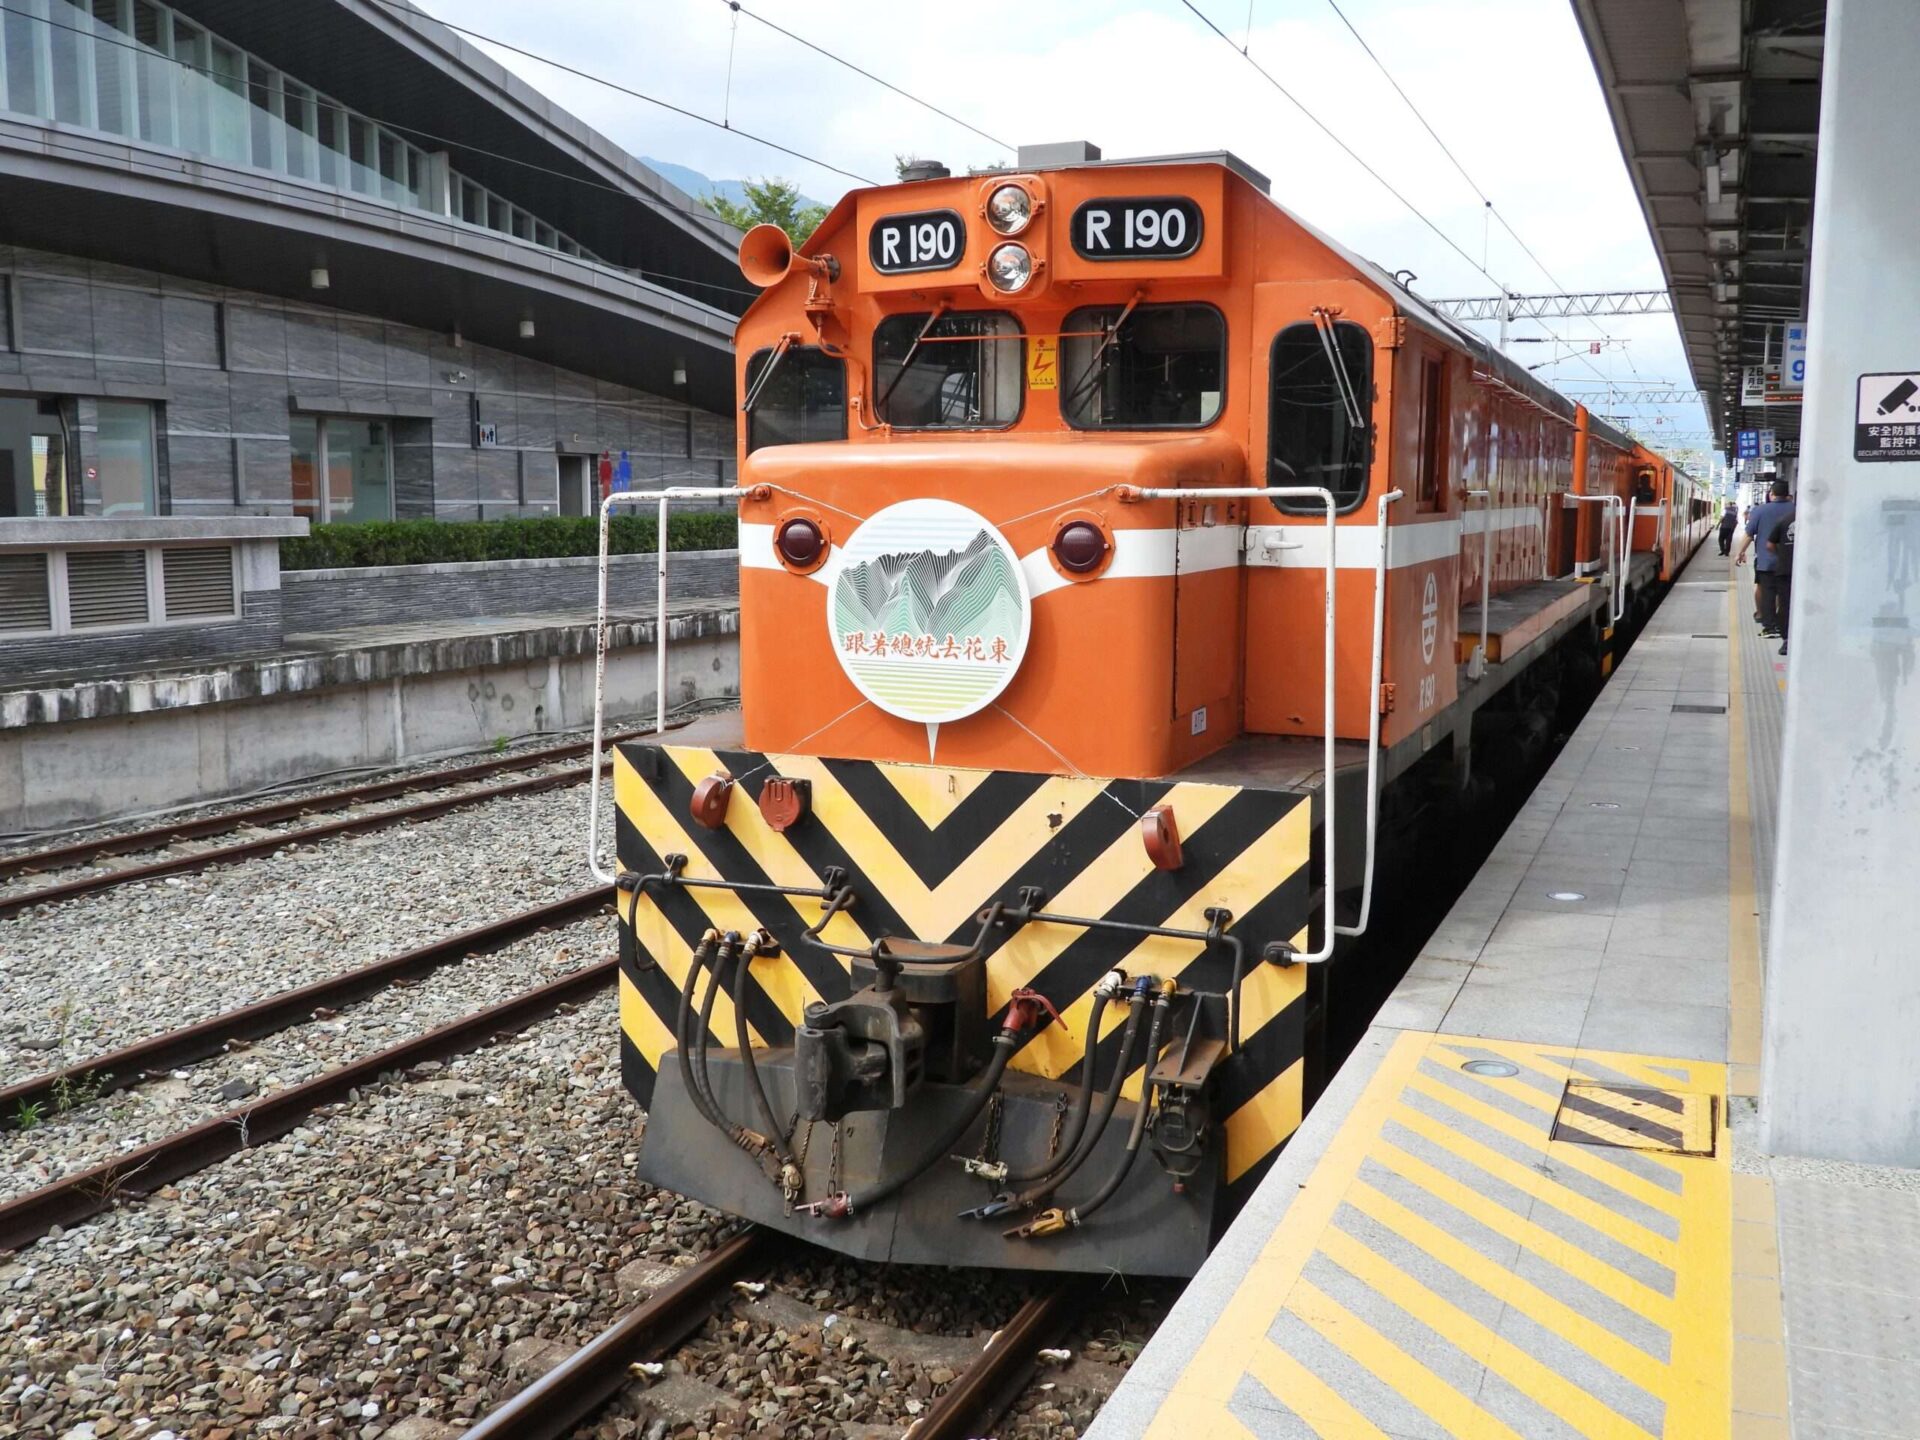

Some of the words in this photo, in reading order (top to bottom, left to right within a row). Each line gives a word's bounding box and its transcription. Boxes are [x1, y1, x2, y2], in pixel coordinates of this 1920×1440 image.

[1086, 210, 1111, 250] R
[1124, 207, 1187, 250] 190
[882, 227, 900, 265] R
[909, 220, 956, 263] 190
[1791, 359, 1805, 381] 9
[1748, 377, 1764, 385] 月台
[1868, 425, 1920, 436] 安全防護
[1764, 444, 1771, 454] 8
[1880, 437, 1917, 448] 監控中
[844, 632, 1012, 664] 跟著總統去花東
